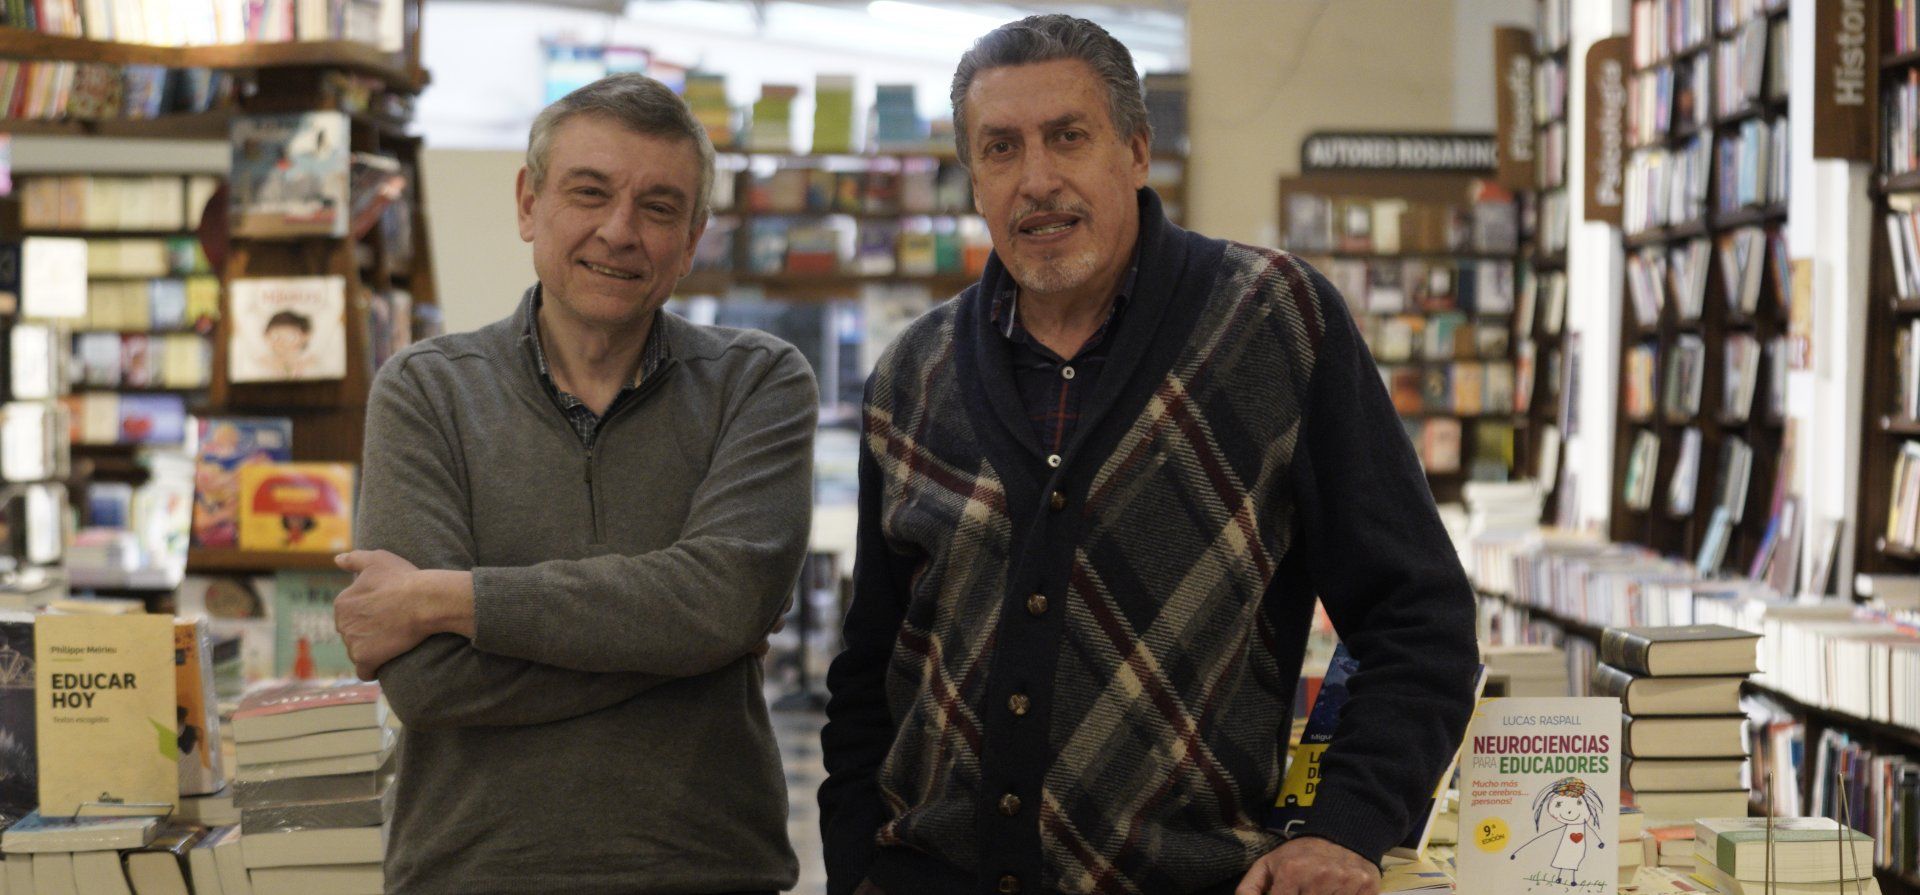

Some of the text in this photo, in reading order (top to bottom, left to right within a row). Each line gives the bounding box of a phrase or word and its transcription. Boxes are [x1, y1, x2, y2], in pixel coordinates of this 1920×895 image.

[1310, 138, 1397, 168] AUTORES
[52, 673, 137, 689] EDUCAR
[52, 692, 95, 708] HOY
[1503, 715, 1581, 726] LUCAS RASPALL
[1474, 735, 1609, 754] NEUROCIENCIAS
[1472, 755, 1609, 774] PARA EDUCADORES
[1472, 779, 1519, 788] Mucho más
